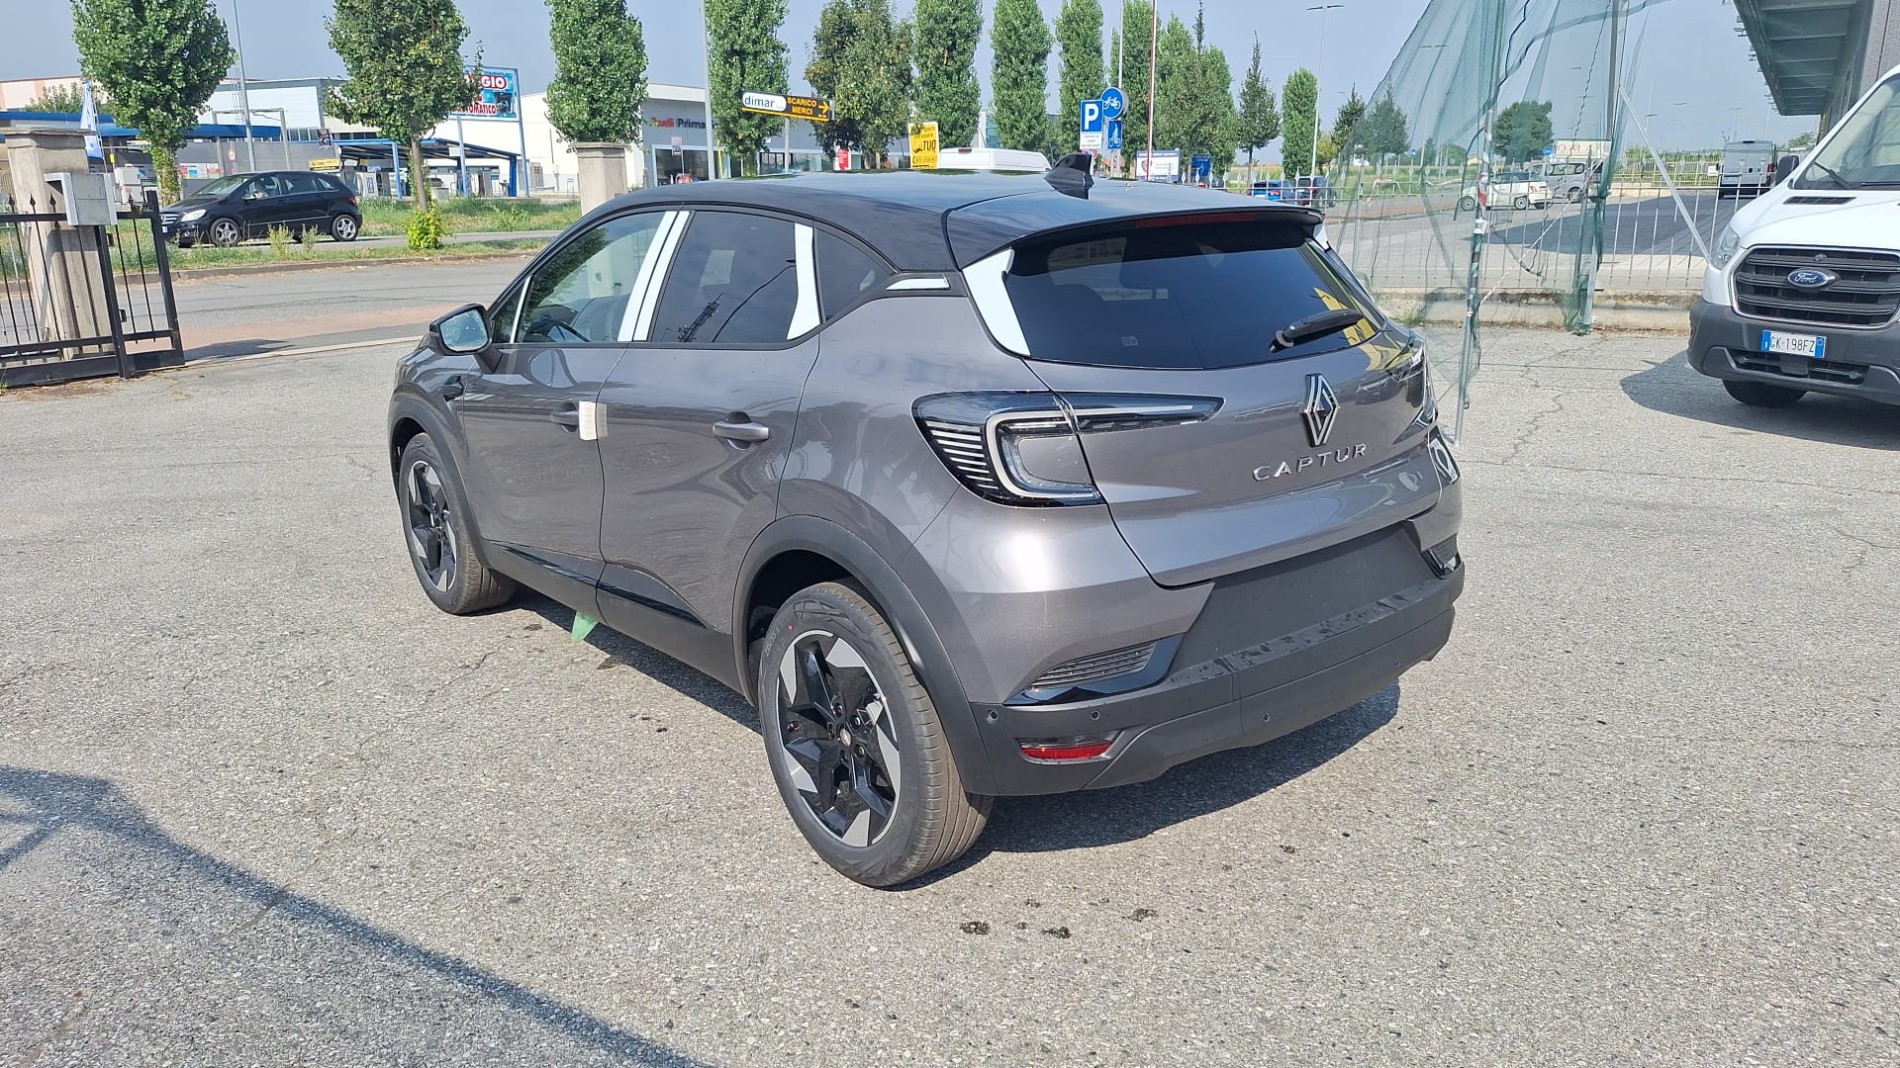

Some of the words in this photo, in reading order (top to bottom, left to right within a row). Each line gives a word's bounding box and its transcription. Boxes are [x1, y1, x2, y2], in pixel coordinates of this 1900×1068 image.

[744, 95, 775, 108] dimar
[786, 97, 817, 108] SCARICO
[791, 106, 813, 115] MERCI
[1084, 103, 1099, 130] P
[1794, 272, 1818, 284] Ford
[1253, 443, 1367, 482] CAPTUR
